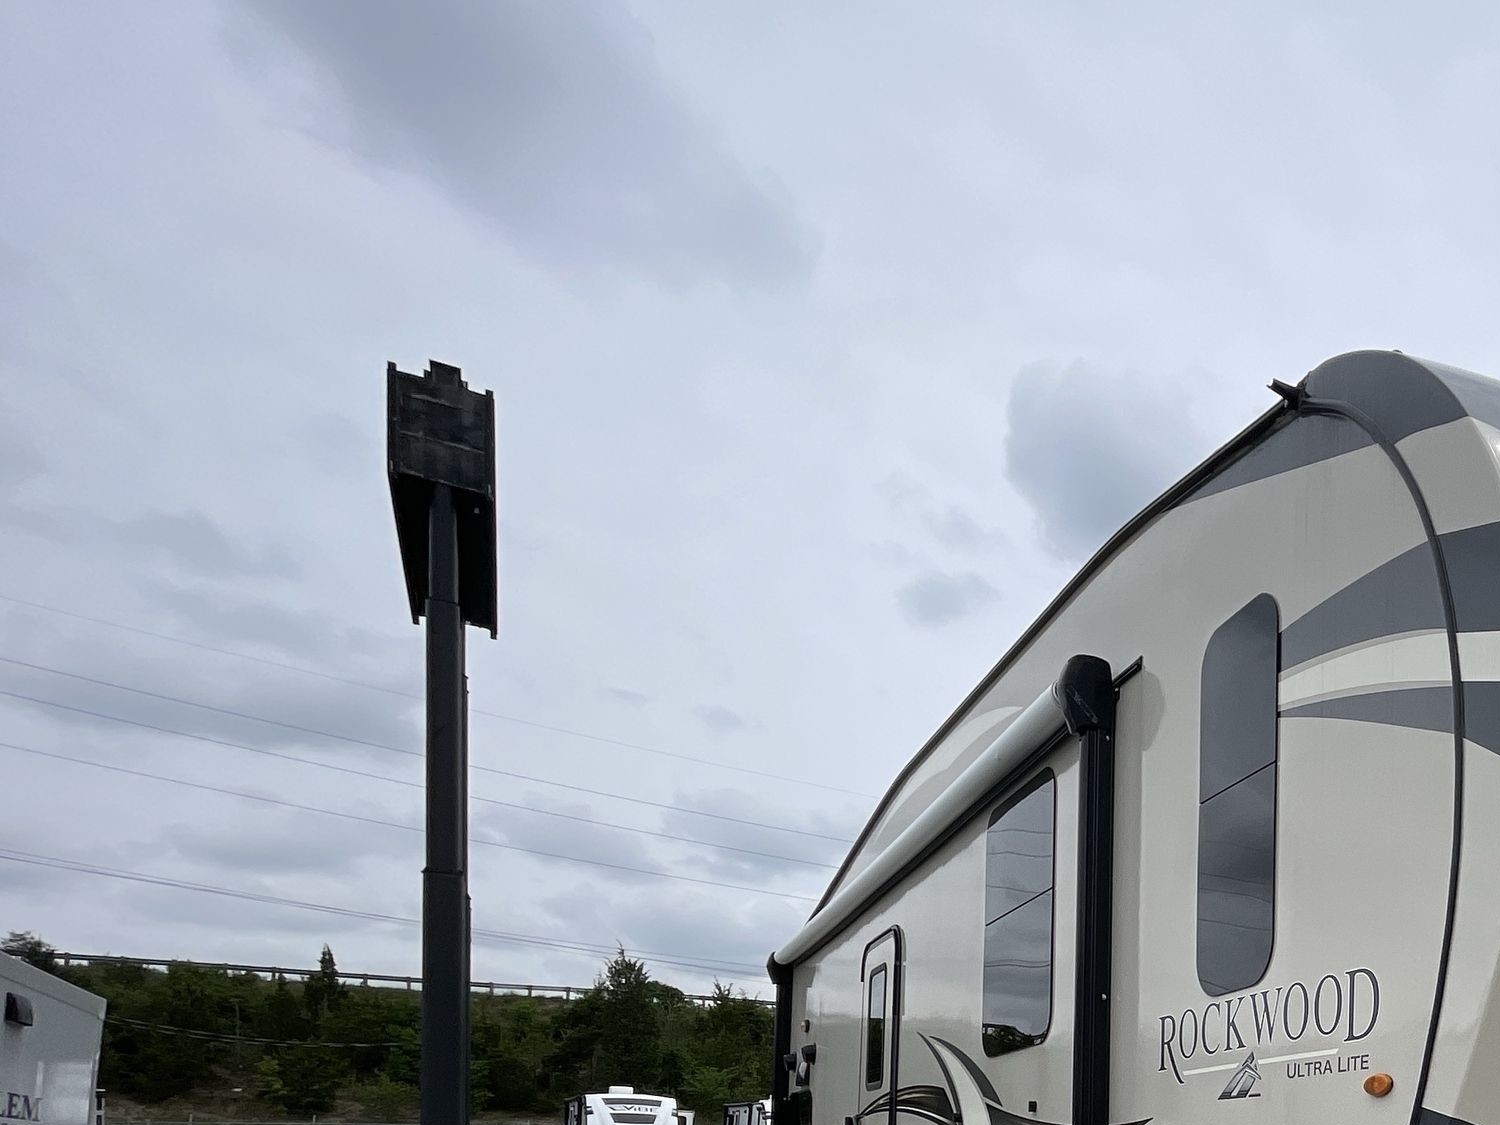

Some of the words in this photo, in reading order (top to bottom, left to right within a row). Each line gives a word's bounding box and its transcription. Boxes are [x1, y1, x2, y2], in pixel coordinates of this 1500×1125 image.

[1158, 968, 1380, 1084] ROCKWOOD
[1286, 1059, 1333, 1079] ULTRA
[1337, 1054, 1370, 1073] LITE
